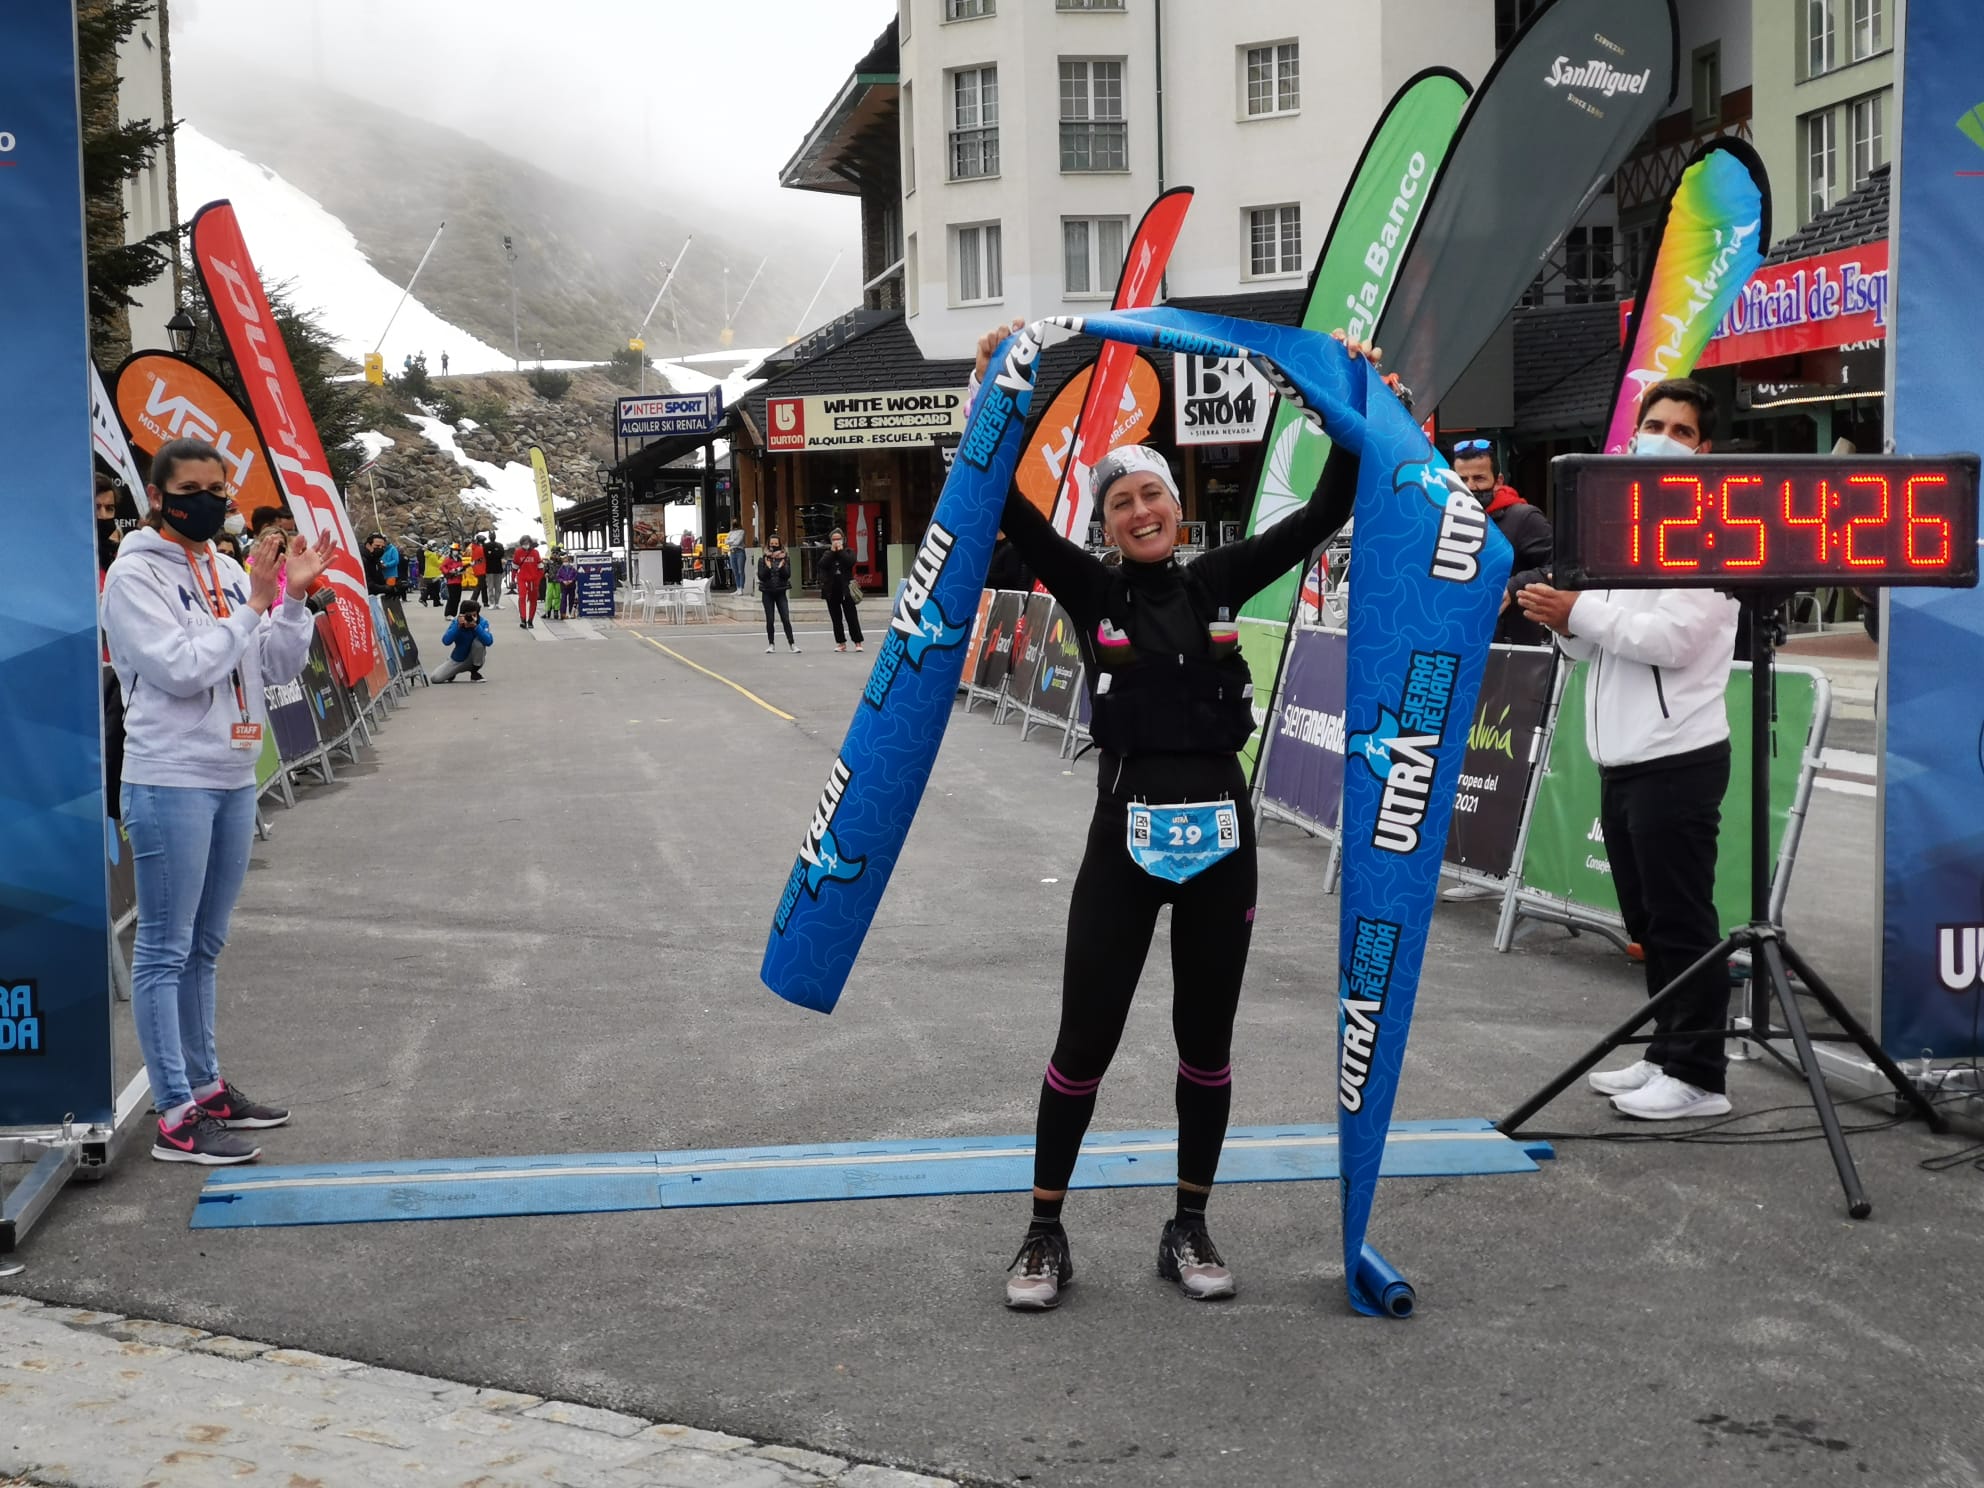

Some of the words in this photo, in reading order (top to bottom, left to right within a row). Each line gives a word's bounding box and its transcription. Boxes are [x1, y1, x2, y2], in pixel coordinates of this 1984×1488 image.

[1364, 151, 1426, 278] Banco
[1729, 267, 1808, 337] Oficial
[1808, 266, 1842, 320] de
[621, 421, 661, 434] ALQUILER
[661, 420, 675, 432] SKI
[676, 418, 708, 432] RENTAL
[823, 400, 883, 415] WHITE
[887, 394, 960, 412] WORLD
[870, 413, 950, 428] SNOWBOARD
[1184, 399, 1257, 426] SNOW
[808, 435, 864, 446] ALQUILER
[872, 432, 923, 443] ESCUELA
[1195, 428, 1219, 437] SIERRA
[1222, 427, 1251, 436] NEVADA
[612, 493, 620, 545] DESAYUNOS
[1627, 473, 1952, 570] 12:54:26
[890, 522, 954, 638] ULTRA
[1401, 653, 1434, 732] SIERRA
[235, 725, 258, 736] STAFF
[1374, 734, 1440, 852] ULTRA
[1483, 773, 1499, 792] del
[800, 756, 851, 868] ULTRA
[1168, 825, 1202, 847] 29
[1350, 919, 1377, 996] SIERRA
[1339, 998, 1382, 1113] ULTRA
